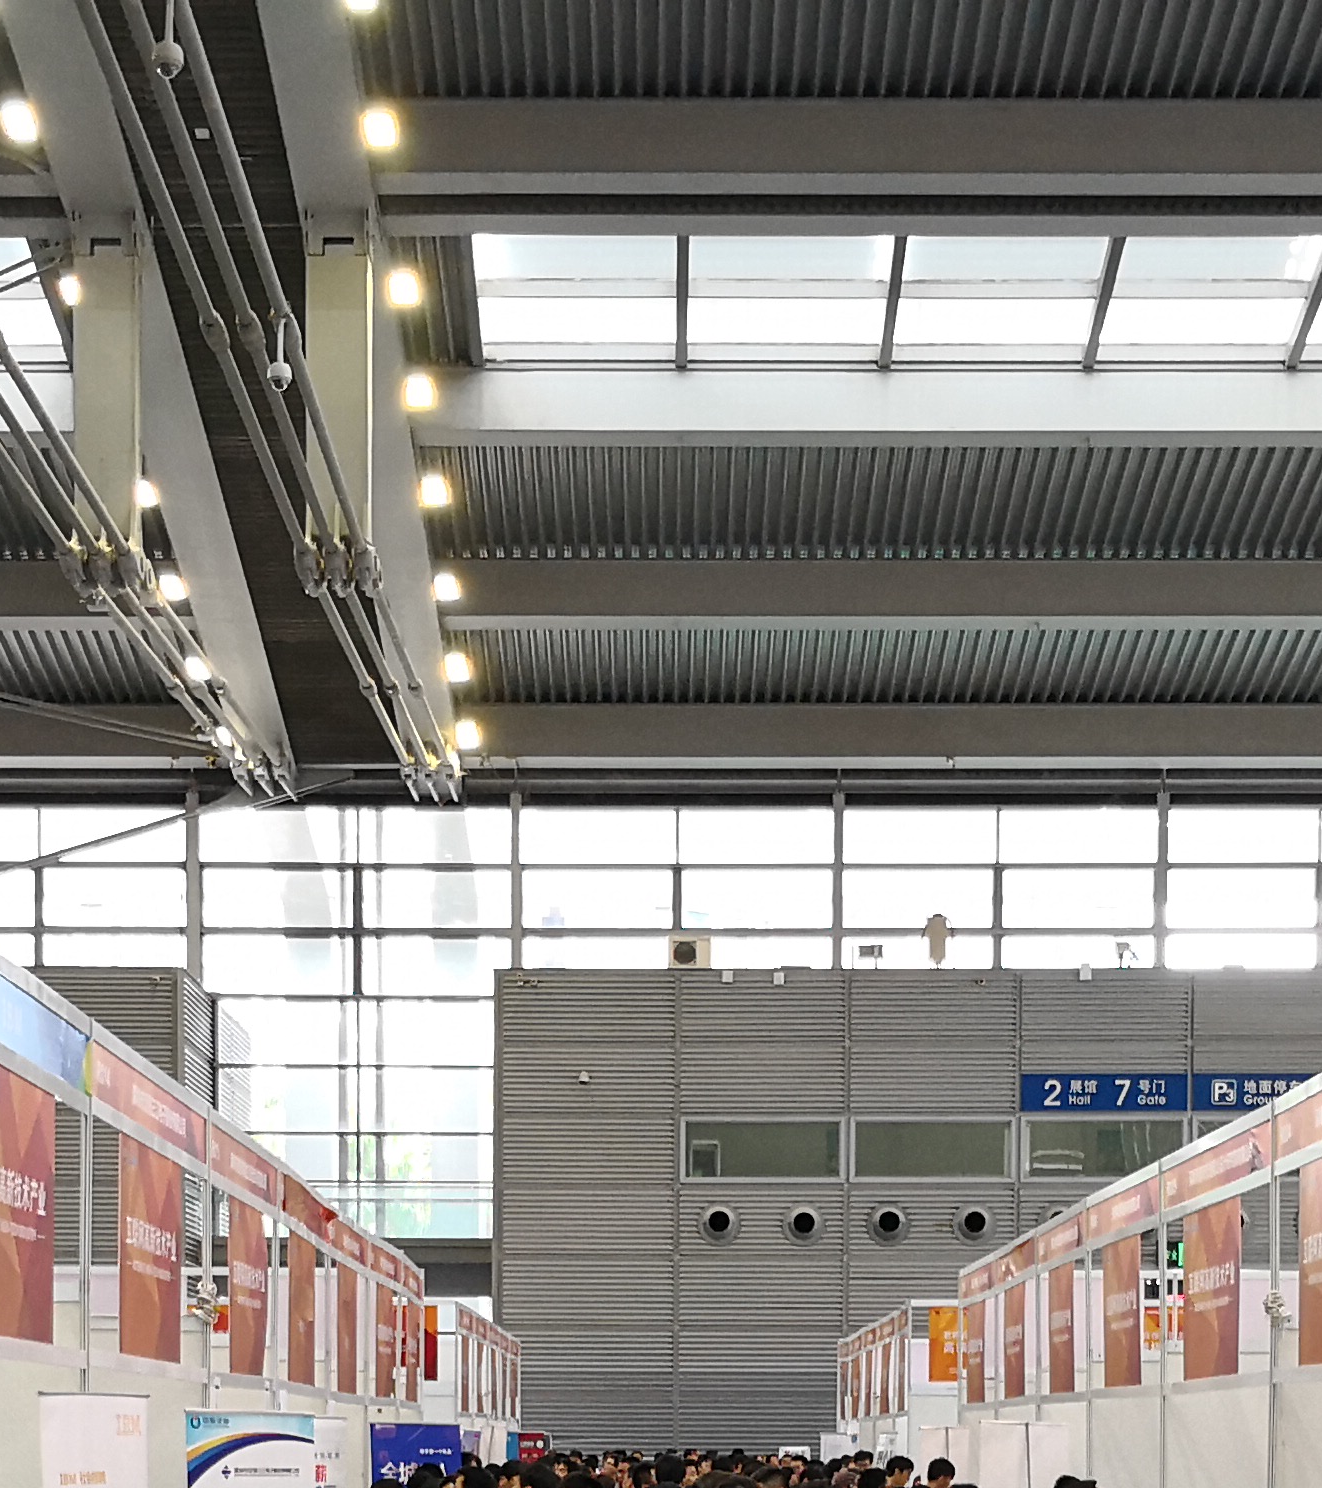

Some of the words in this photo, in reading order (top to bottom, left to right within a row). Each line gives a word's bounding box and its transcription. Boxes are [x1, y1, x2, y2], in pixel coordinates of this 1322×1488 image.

[1043, 1079, 1062, 1107] 2
[1114, 1079, 1131, 1107] 7
[1137, 1078, 1166, 1095] 号门
[1068, 1094, 1091, 1106] Hall
[1137, 1094, 1167, 1106] Gate
